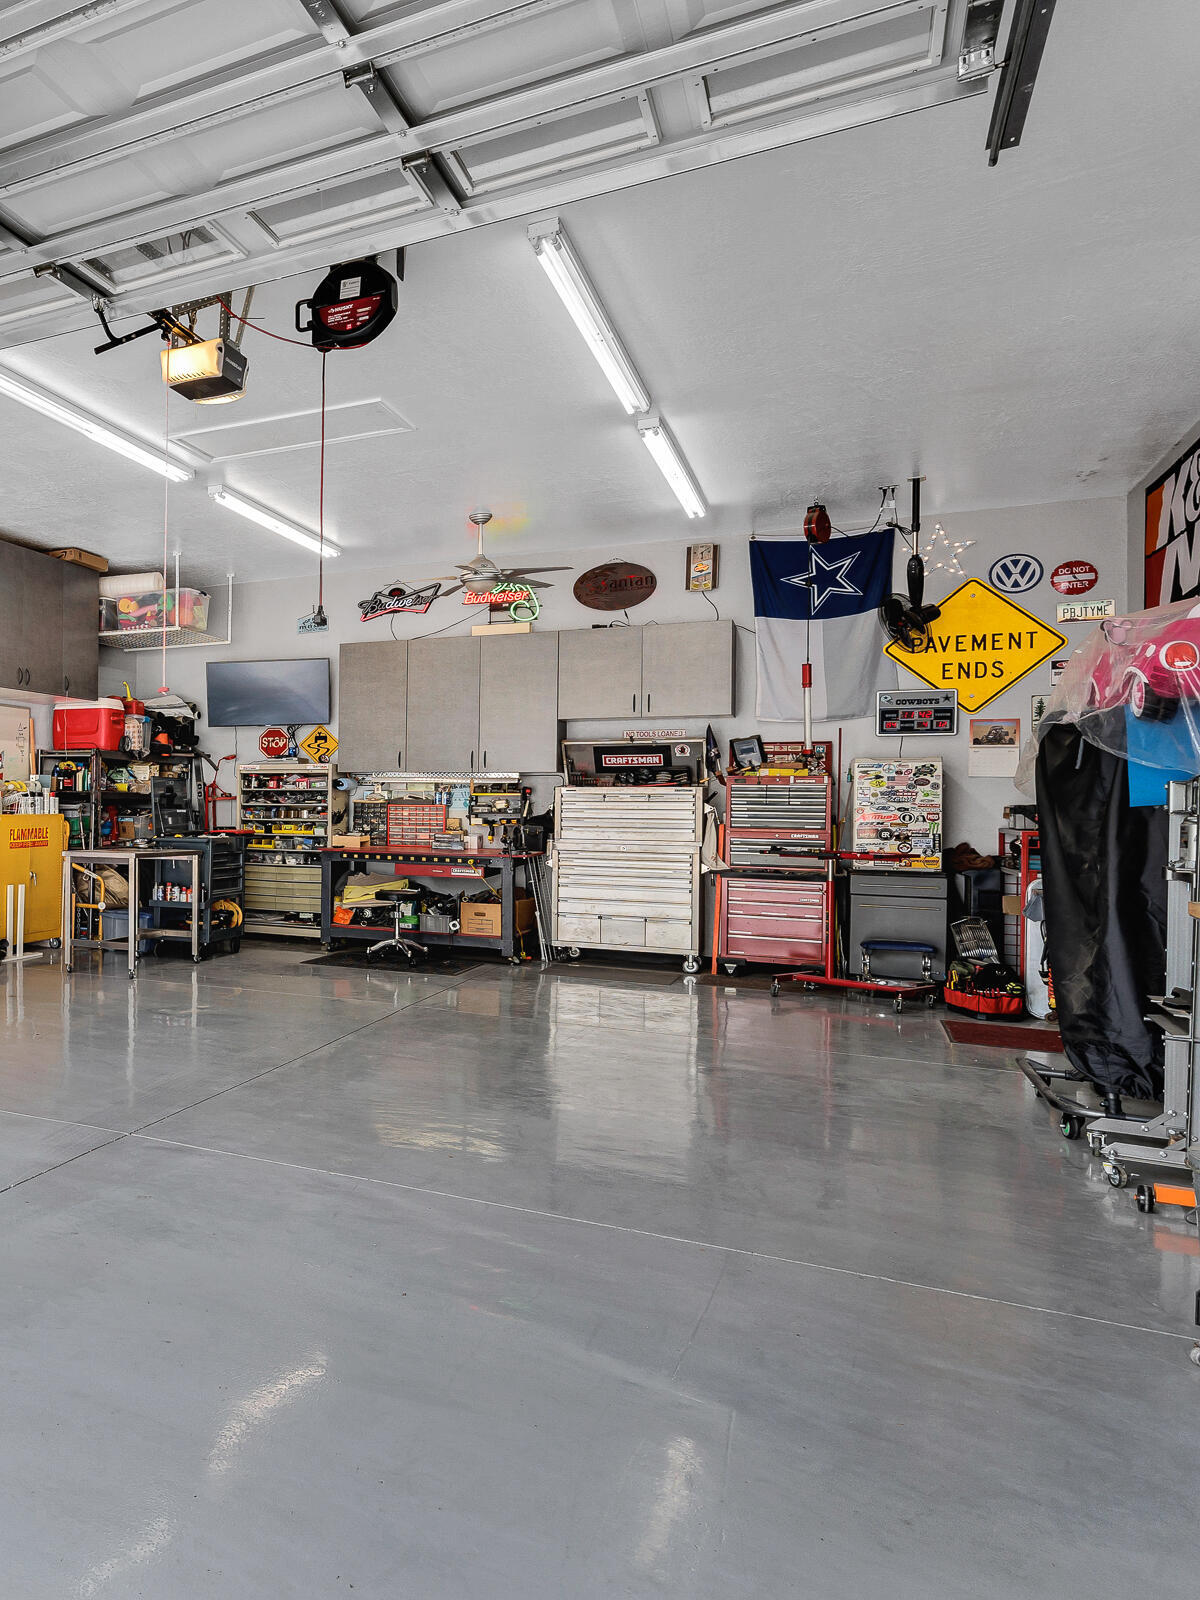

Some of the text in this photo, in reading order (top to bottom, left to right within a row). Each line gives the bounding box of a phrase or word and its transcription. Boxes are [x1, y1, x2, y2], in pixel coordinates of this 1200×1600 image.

[1058, 566, 1091, 575] DO NOT
[1060, 581, 1089, 590] ENTER
[358, 593, 437, 614] Budweiser
[464, 590, 530, 604] Budweiser
[1062, 604, 1110, 618] PBJTYME
[911, 631, 1038, 654] PAVEMENT
[942, 660, 1005, 680] ENDS
[895, 698, 940, 706] COWBOYS
[262, 736, 286, 748] STOP
[605, 756, 660, 764] CRAFTSMAN
[10, 827, 48, 841] FLAMMABLE
